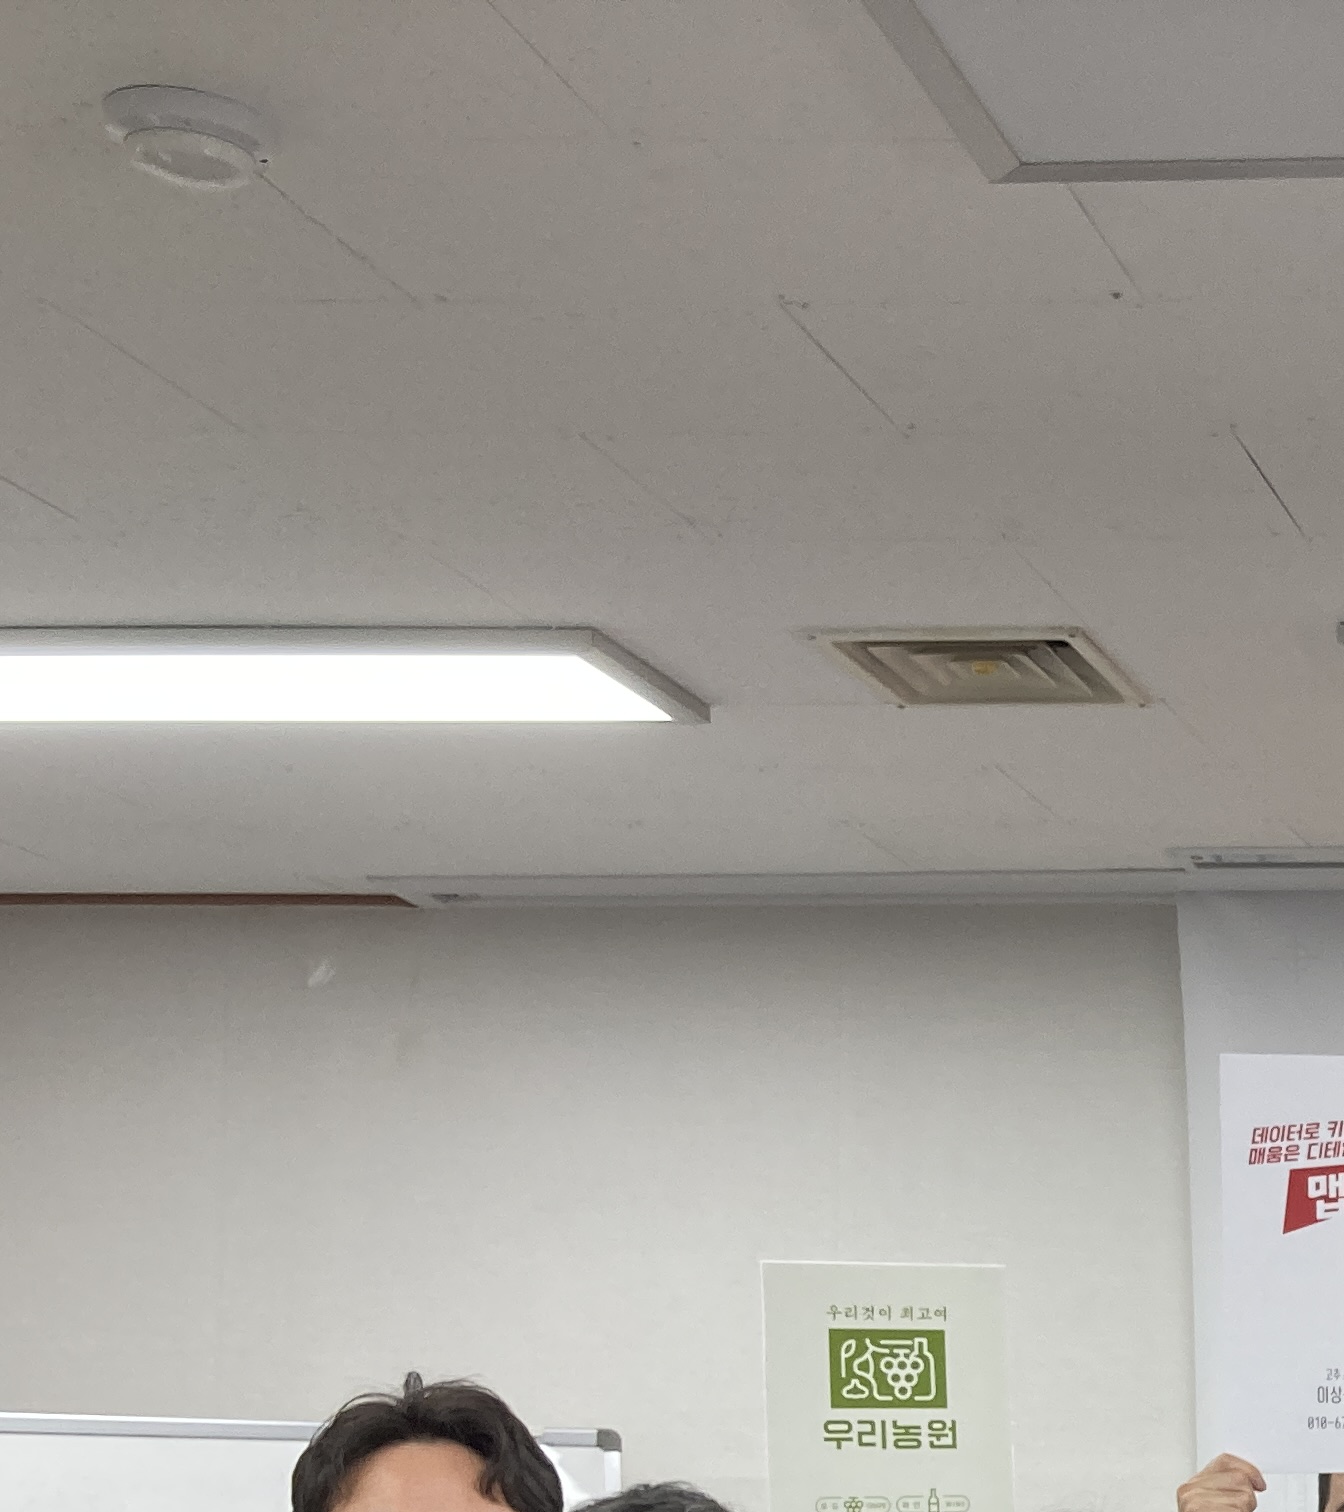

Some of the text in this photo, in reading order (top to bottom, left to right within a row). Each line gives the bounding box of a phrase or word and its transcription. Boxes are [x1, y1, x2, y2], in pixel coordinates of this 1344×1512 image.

[1251, 1121, 1320, 1146] 데이터로
[1248, 1145, 1301, 1166] 매움은
[826, 1304, 892, 1321] 우리것이
[823, 1419, 958, 1450] 우리농원
